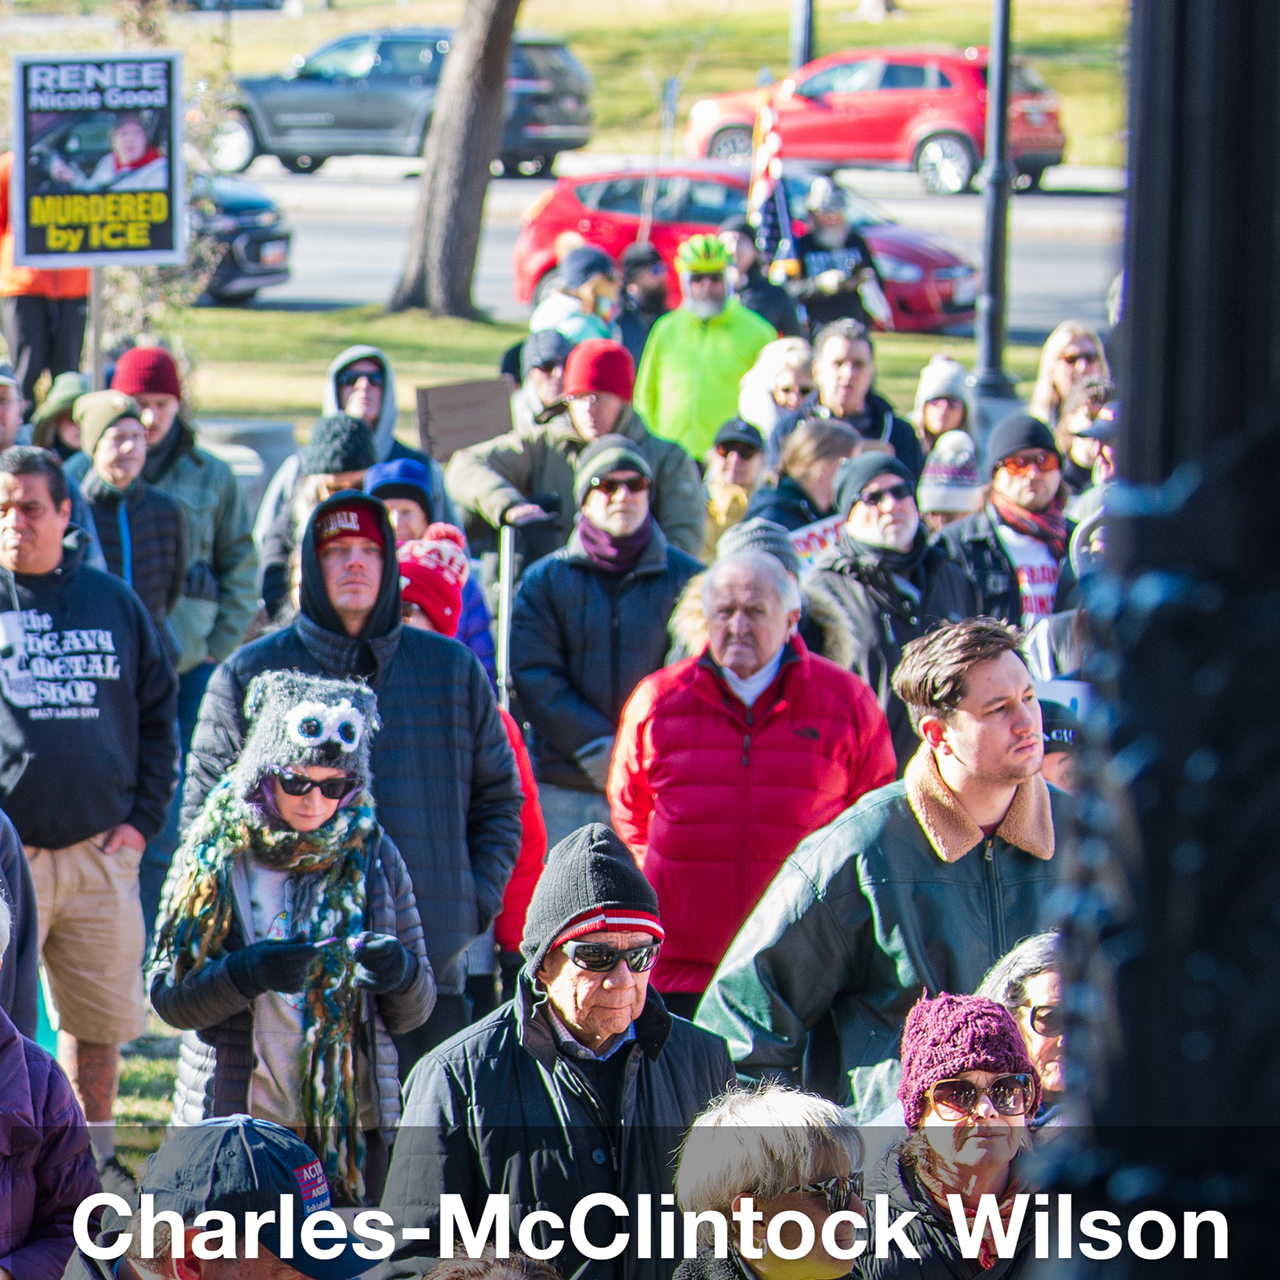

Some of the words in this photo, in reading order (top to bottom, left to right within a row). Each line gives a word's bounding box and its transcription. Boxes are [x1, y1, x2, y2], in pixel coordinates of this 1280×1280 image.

[29, 62, 168, 90] RENEE
[29, 90, 102, 111] Nicole
[104, 87, 168, 108] Good
[30, 192, 169, 227] MURDERED
[46, 223, 84, 252] by
[89, 221, 151, 248] ICE
[22, 608, 53, 631] the
[30, 654, 121, 680] METAL
